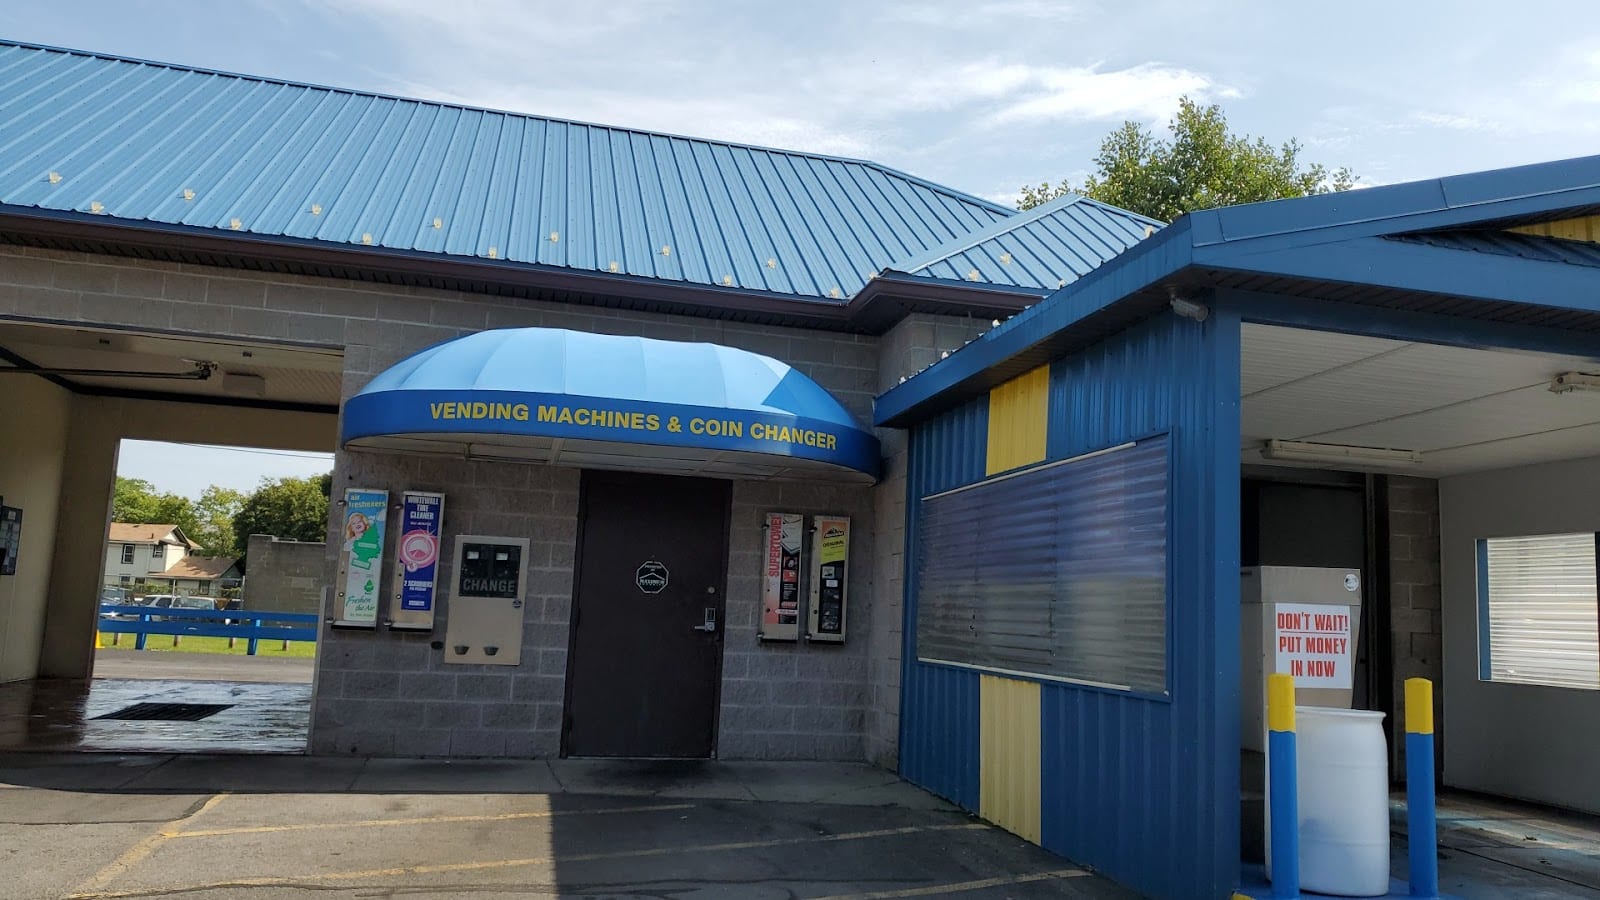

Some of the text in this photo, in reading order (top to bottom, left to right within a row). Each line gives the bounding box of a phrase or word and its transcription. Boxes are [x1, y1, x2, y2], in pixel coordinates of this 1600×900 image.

[430, 402, 837, 450] VENDING MACHINES & COIN CHANGER
[410, 511, 434, 520] CLEANER
[462, 578, 515, 593] CHANGE
[1277, 611, 1349, 632] DON'T WAIT!
[1279, 636, 1348, 655] PUT MONEY
[1291, 659, 1336, 678] IN NOW
